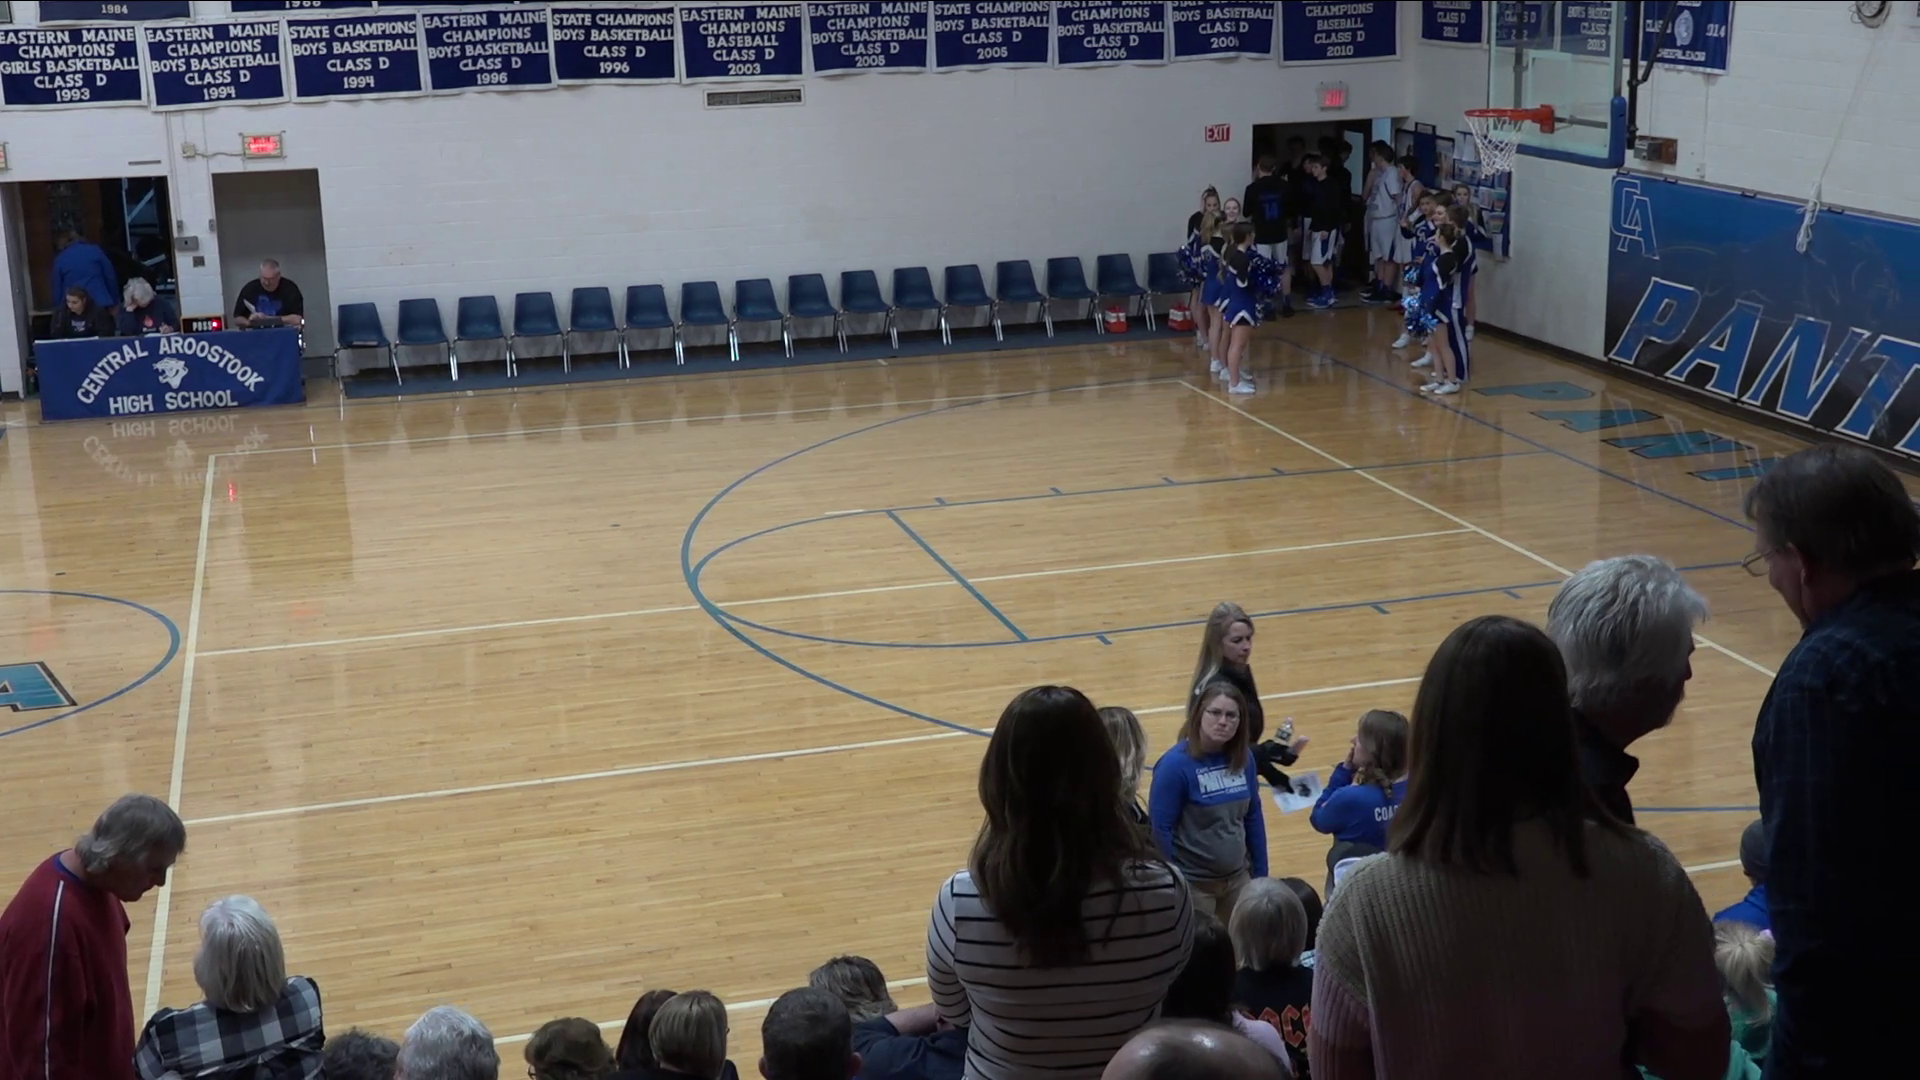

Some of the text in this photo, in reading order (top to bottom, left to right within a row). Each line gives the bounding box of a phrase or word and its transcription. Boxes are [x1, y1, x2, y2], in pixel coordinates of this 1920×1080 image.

[101, 5, 128, 14] 1984
[681, 6, 800, 21] EASTERN MAINE
[809, 1, 927, 17] EASTERN MAINE
[934, 1, 1049, 16] STATE CHAMPIONS
[1071, 7, 1150, 21] CHAMPIONS
[1173, 10, 1200, 21] BOYS
[1306, 3, 1374, 17] CHAMPIONS
[424, 11, 547, 28] EASTERN MAINE
[552, 13, 674, 26] STATE CHAMPIONS
[827, 16, 910, 31] CHAMPIONS
[1317, 17, 1363, 30] BASEBALL
[1437, 11, 1459, 23] CLASS
[1504, 11, 1528, 22] CLAS
[290, 21, 416, 39] STATE CHAMPIONS
[699, 21, 785, 35] CHAMPIONS
[935, 16, 1050, 33] BOYS BASKETBALL
[1057, 21, 1164, 36] BOYS BASKETBALL
[1239, 21, 1249, 33] D
[1580, 22, 1609, 35] CLASS
[0, 29, 135, 45] EASTERN MAINE
[146, 23, 279, 43] EASTERN MAINE
[443, 27, 531, 43] CHAMPIONS
[553, 29, 674, 42] BOYS BASKETBALL
[812, 28, 927, 45] BOYS BASKETBALL
[962, 31, 1022, 45] CLASS D
[1314, 31, 1365, 44] CLASS D
[167, 39, 261, 57] CHAMPIONS
[292, 38, 418, 57] BOYS BASKETBALL
[707, 35, 779, 48] BASEBALL
[1083, 35, 1139, 48] CLASS D
[19, 44, 115, 59] CHAMPIONS
[428, 42, 549, 59] BOYS BASKETBALL
[584, 46, 646, 58] CLASS D
[713, 49, 775, 61] CLASS D
[841, 42, 900, 56] CLASS D
[977, 47, 1008, 60] 2005
[1097, 48, 1127, 59] 2006
[1327, 46, 1353, 56] 2010
[1, 57, 139, 74] GIRLS BASKETBALL
[152, 53, 279, 73] BOYS BASKETBALL
[327, 57, 390, 72] CLASS D
[459, 57, 522, 71] CLASS D
[599, 62, 630, 74] 1996
[855, 55, 886, 67] 2005
[728, 64, 761, 75] 2003
[34, 73, 107, 89] CLASS D
[184, 70, 250, 86] CLASS D
[343, 76, 375, 89] 1994
[476, 72, 508, 85] 1996
[56, 88, 90, 102] 1993
[203, 86, 236, 100] 1994
[1207, 126, 1230, 141] EXIT
[77, 337, 264, 404] CENTRAL AROOSTOOK
[109, 390, 238, 415] HIGH SCHOOL
[1374, 804, 1398, 822] COA
